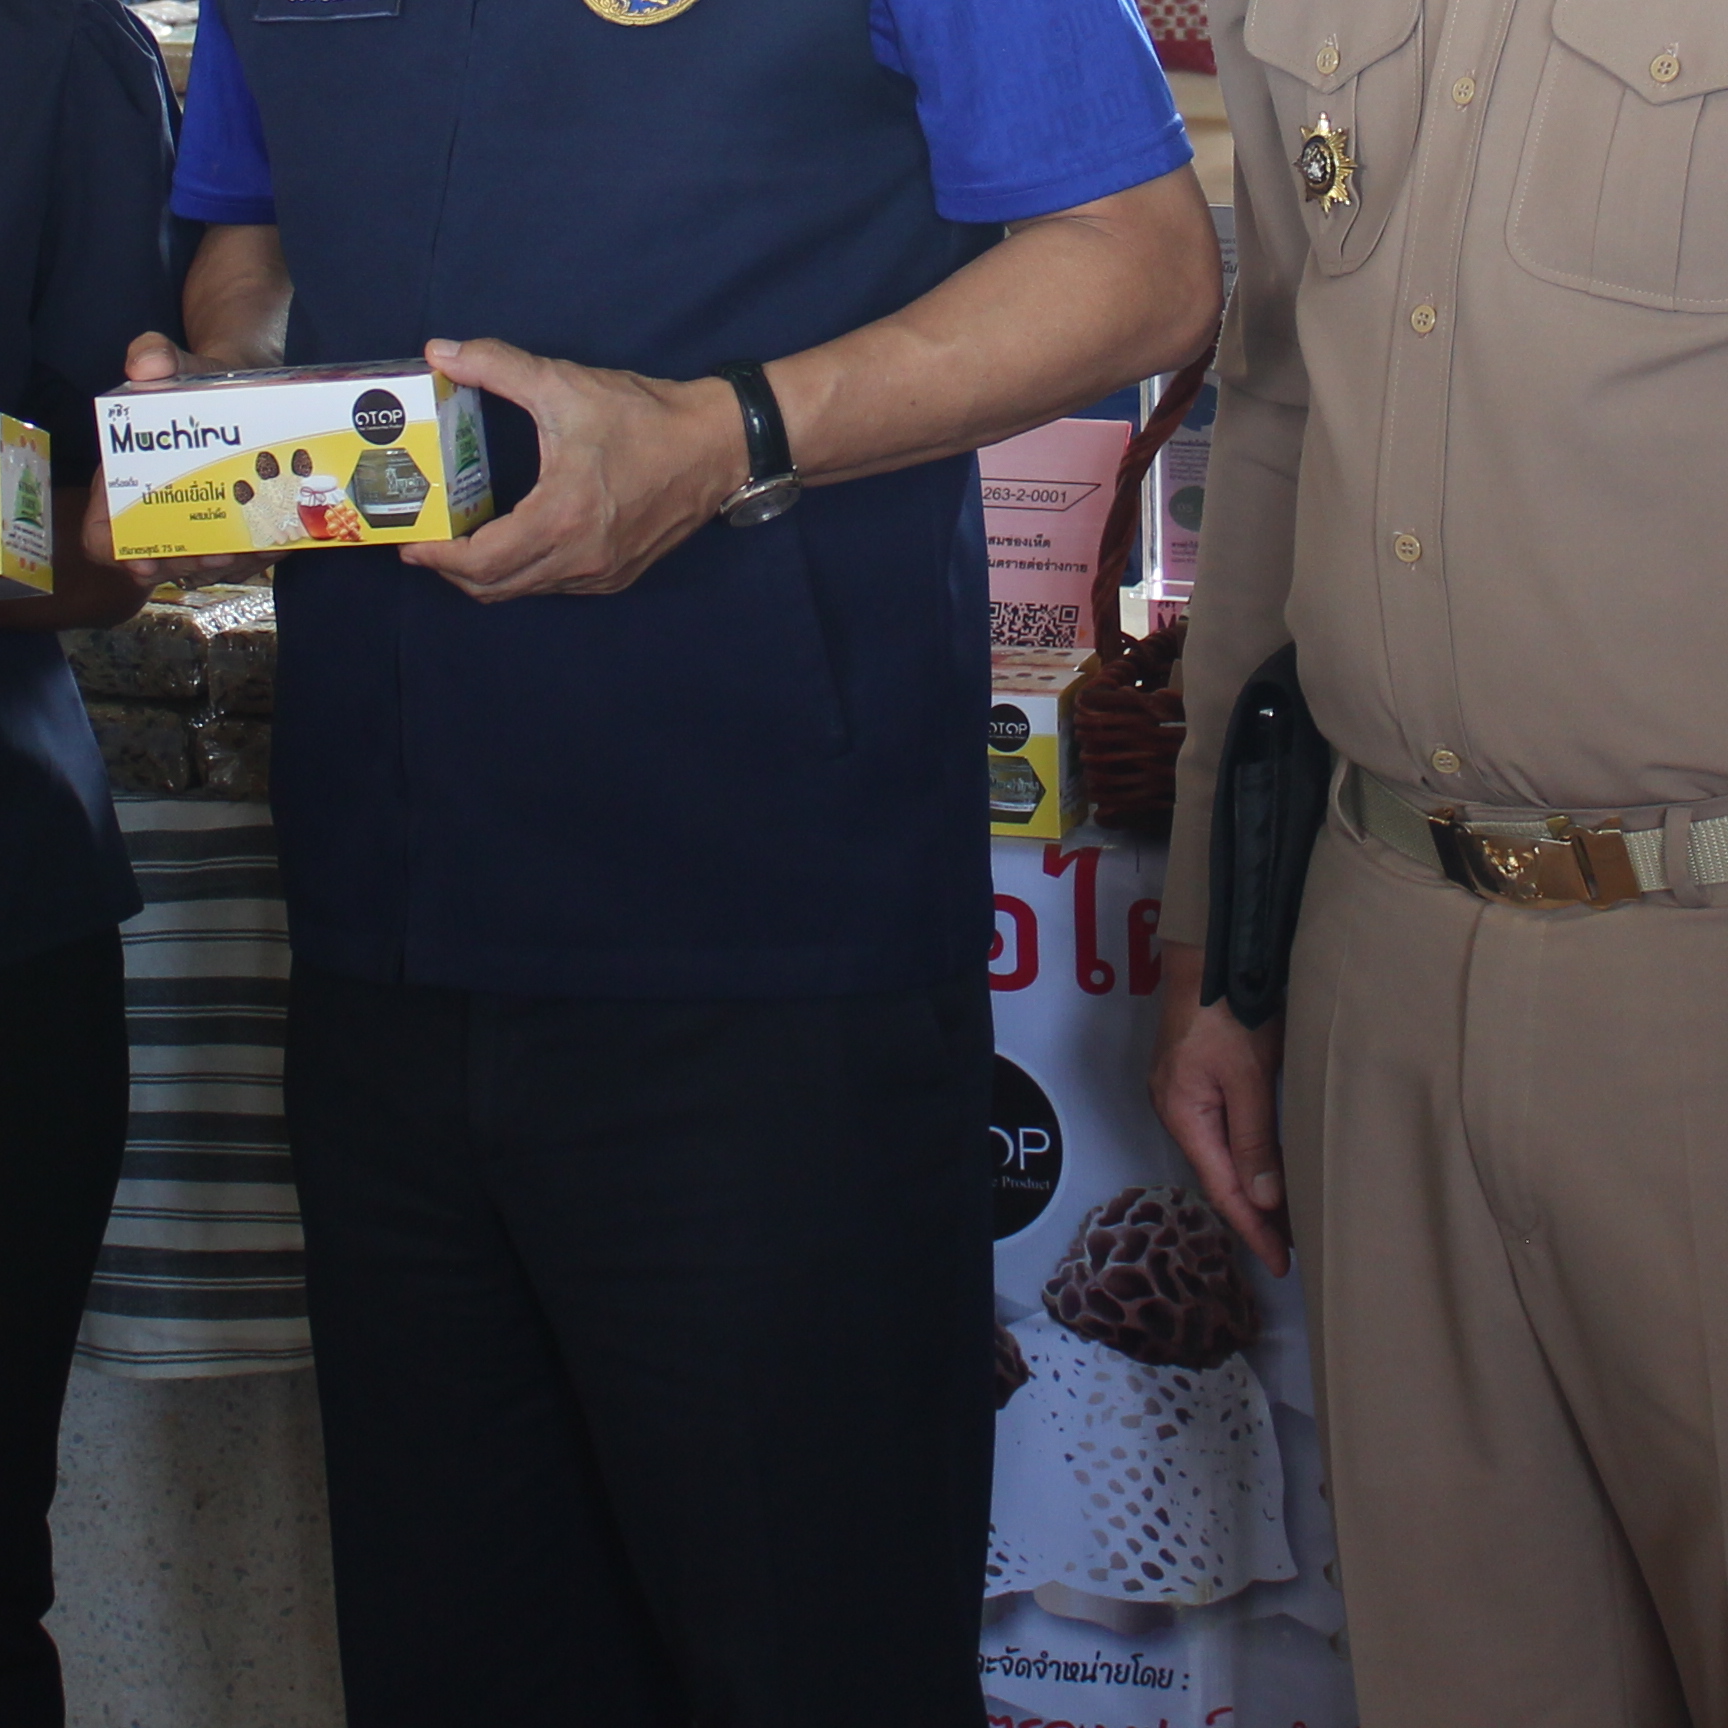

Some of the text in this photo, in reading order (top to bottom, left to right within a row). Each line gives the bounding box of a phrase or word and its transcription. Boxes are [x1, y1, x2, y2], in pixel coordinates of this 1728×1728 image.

[355, 409, 403, 427] OTOP
[109, 416, 241, 454] Muchiru
[983, 487, 1067, 503] 263-2-0001
[161, 544, 173, 553] 75
[1001, 1175, 1051, 1191] Product
